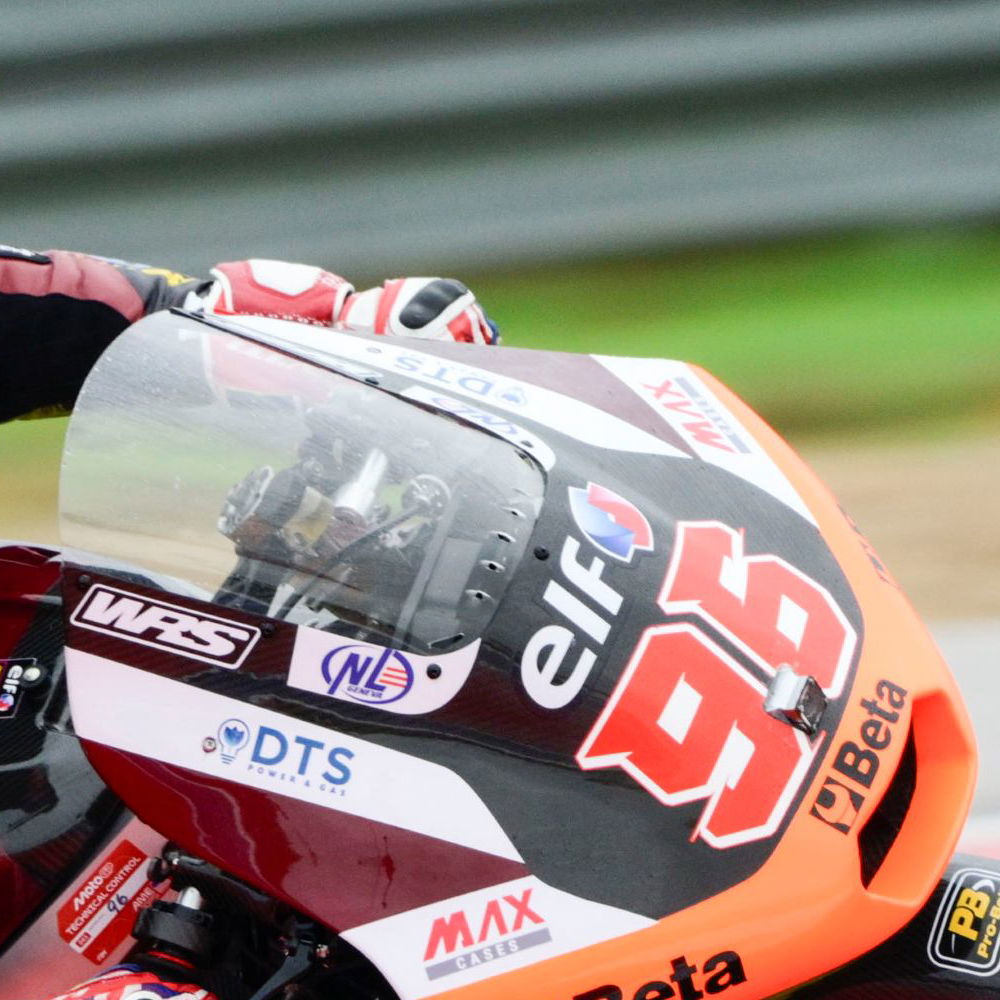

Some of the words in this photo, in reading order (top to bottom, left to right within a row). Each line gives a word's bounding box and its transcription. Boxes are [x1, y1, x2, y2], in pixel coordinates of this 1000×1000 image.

[80, 588, 252, 658] WRS
[520, 540, 624, 710] elf
[575, 519, 857, 849] 96
[251, 725, 355, 786] DTS
[831, 679, 909, 793] Beta
[248, 764, 296, 783] POWER
[320, 783, 347, 797] GAS
[65, 892, 109, 935] TECHNICAL
[105, 856, 142, 893] CONTROL
[107, 893, 129, 913] 96
[423, 888, 546, 962] MAX
[948, 888, 991, 941] PB
[455, 939, 520, 970] CASES
